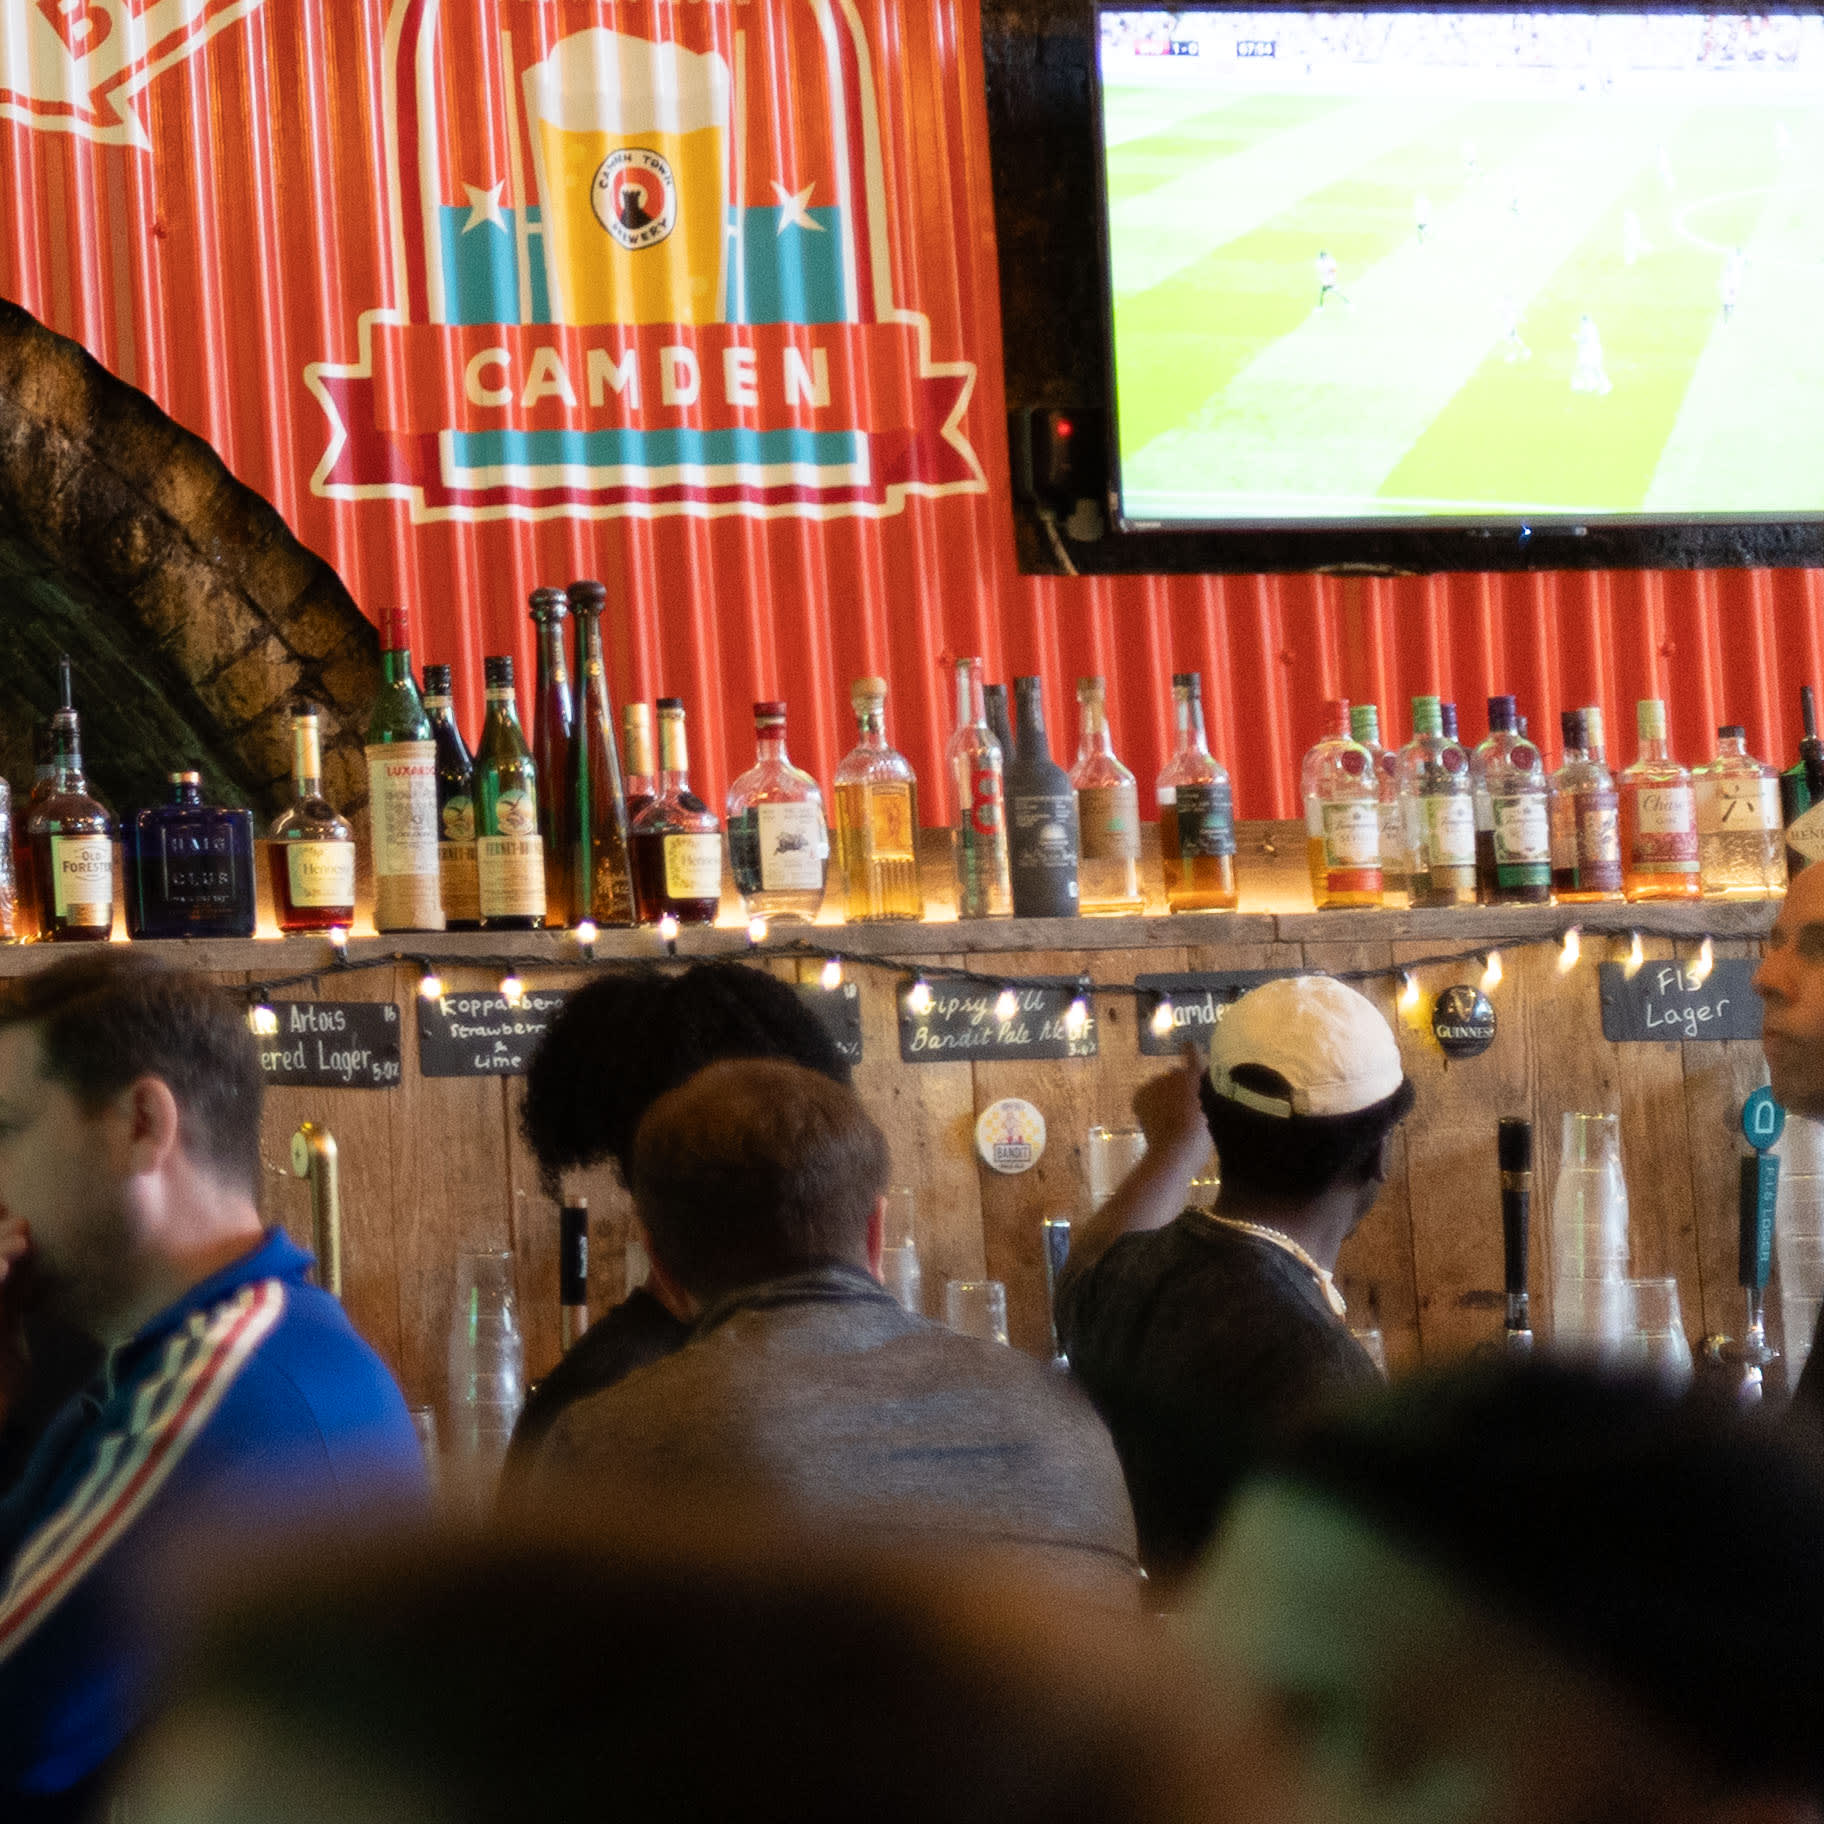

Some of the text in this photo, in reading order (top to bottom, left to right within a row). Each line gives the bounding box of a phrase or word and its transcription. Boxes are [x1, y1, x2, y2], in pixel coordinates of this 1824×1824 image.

[463, 344, 829, 410] CAMDEN
[81, 851, 98, 862] OLD
[290, 1004, 346, 1034] Artois
[1646, 998, 1730, 1037] Lager
[909, 1026, 991, 1051] Bandit
[1435, 1026, 1494, 1039] GUINNESS
[318, 1040, 372, 1081] Lager
[474, 1053, 522, 1069] Lime
